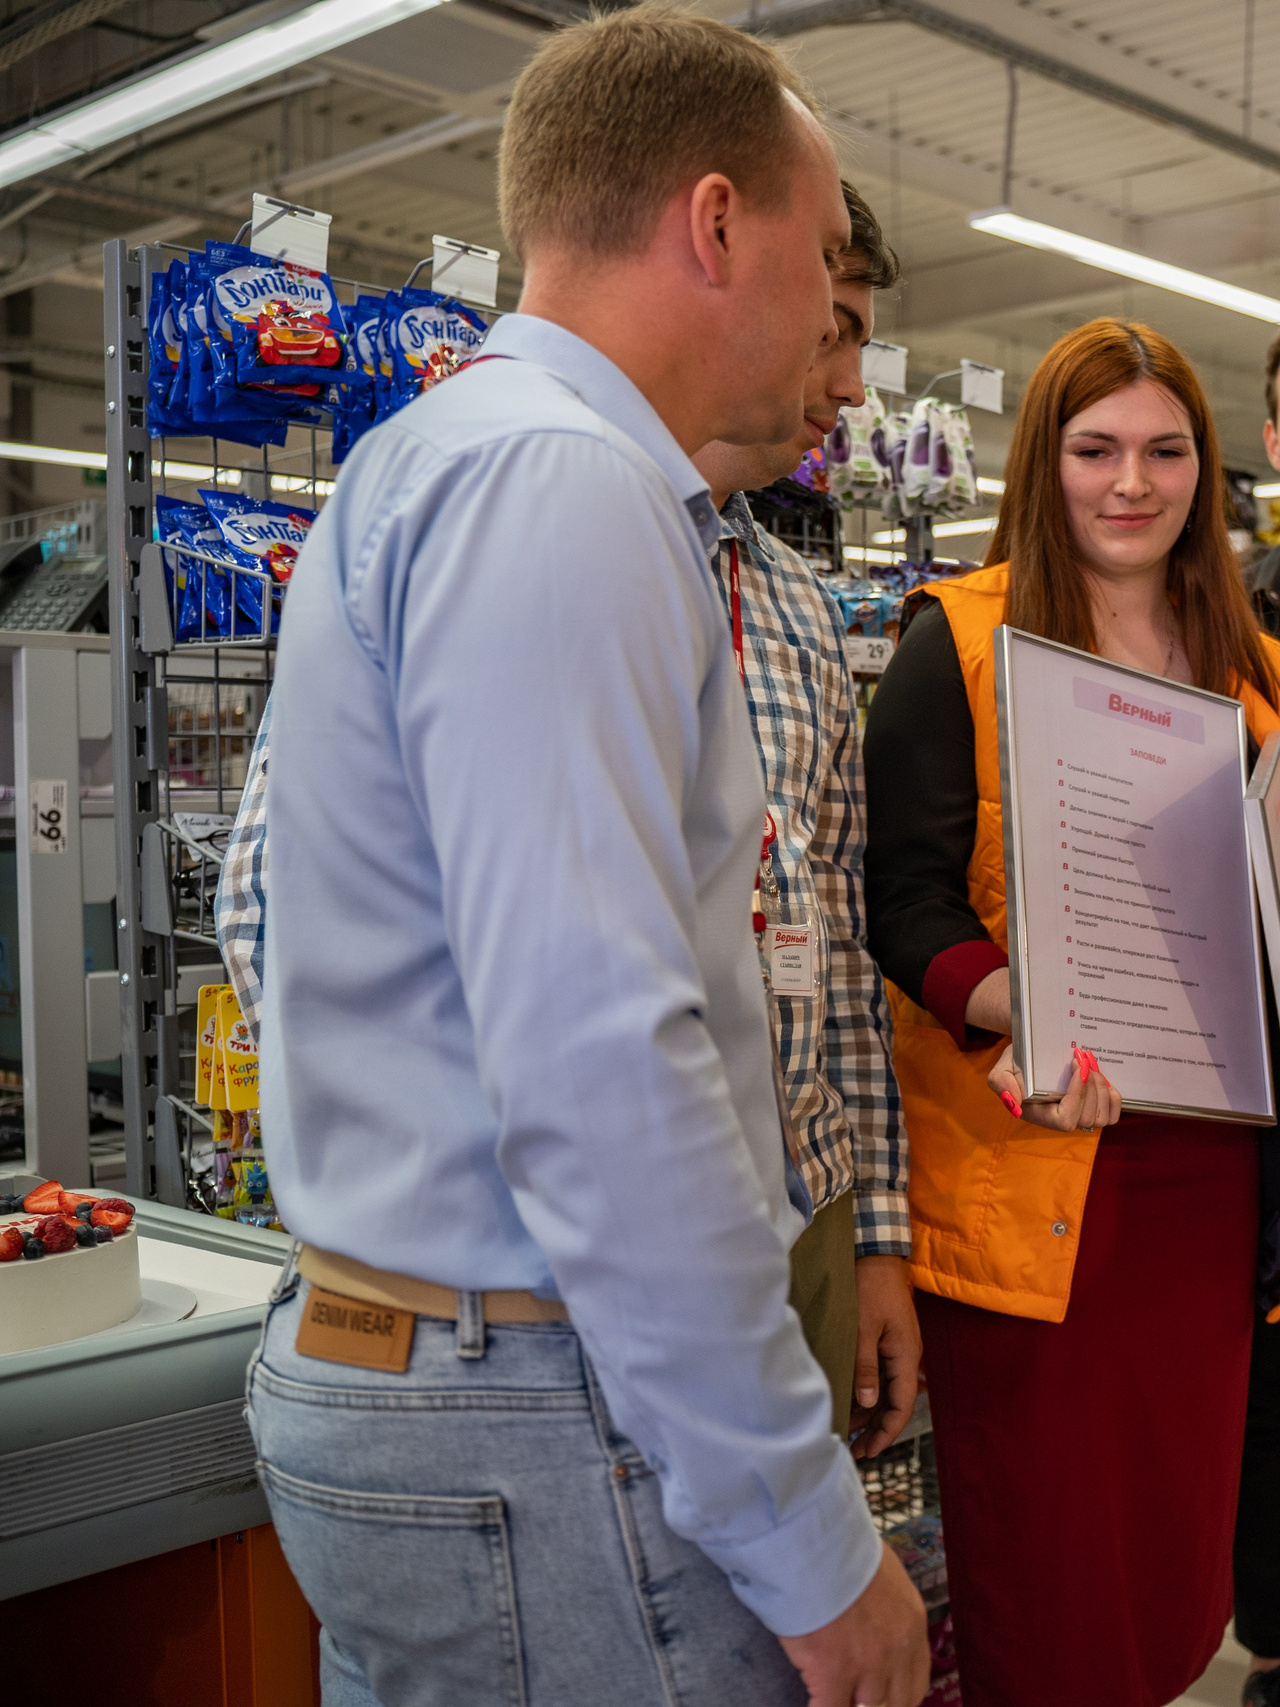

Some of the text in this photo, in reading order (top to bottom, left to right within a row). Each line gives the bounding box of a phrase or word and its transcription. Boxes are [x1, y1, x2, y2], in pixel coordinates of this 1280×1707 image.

[405, 315, 481, 349] БонПар
[1129, 748, 1167, 765] ЗАПОВЕДИ
[40, 810, 61, 840] 66
[775, 931, 808, 944] Верный
[229, 1041, 251, 1053] ТРИ
[350, 1309, 396, 1337] WEAR
